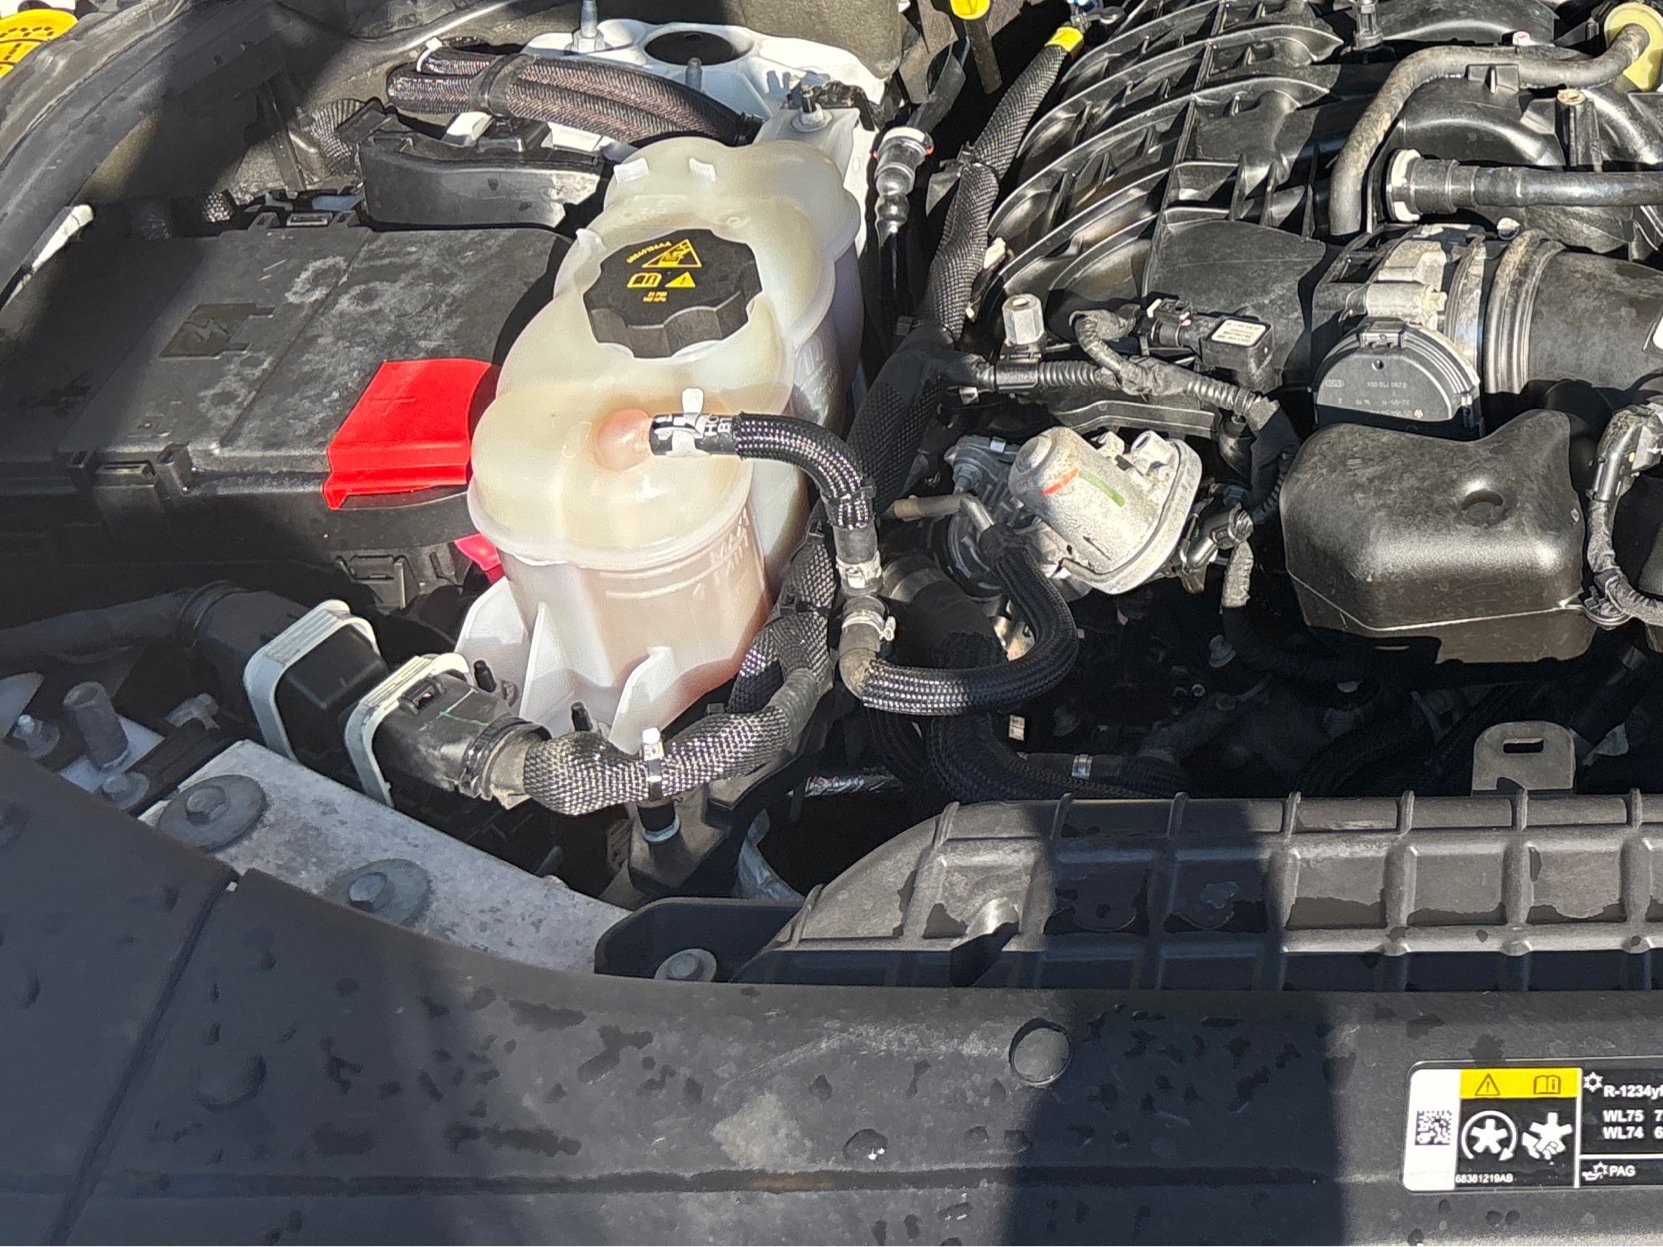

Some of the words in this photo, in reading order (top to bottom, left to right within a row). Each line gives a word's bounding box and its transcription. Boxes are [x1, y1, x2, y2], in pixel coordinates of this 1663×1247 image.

[1602, 1109, 1644, 1122] WL75
[1602, 1126, 1644, 1139] WL74
[1609, 1165, 1636, 1177] PAG
[1455, 1173, 1513, 1183] 68381219AB
